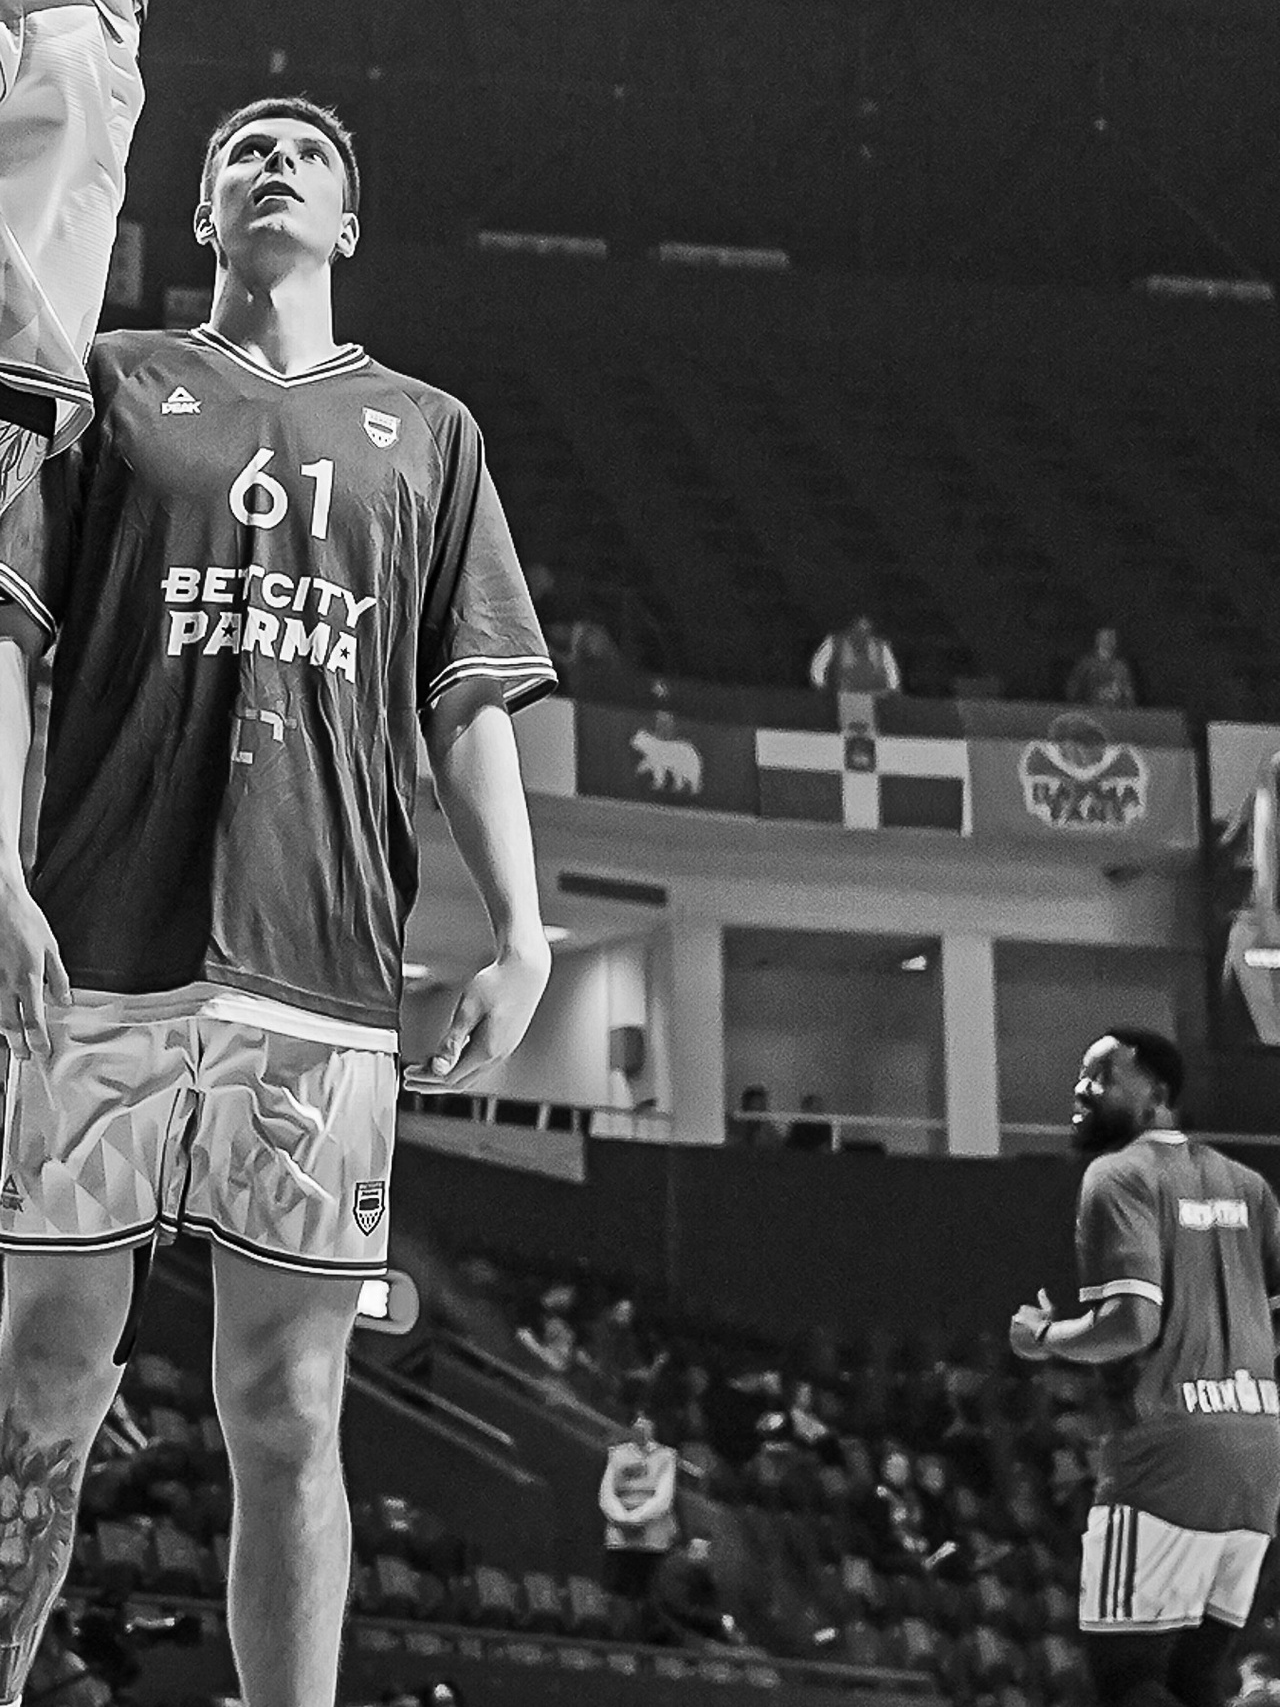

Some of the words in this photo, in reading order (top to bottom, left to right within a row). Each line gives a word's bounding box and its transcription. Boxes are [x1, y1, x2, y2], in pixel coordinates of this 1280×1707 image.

[228, 447, 335, 540] 61
[161, 564, 377, 628] BETCITY
[167, 606, 358, 684] PARMA
